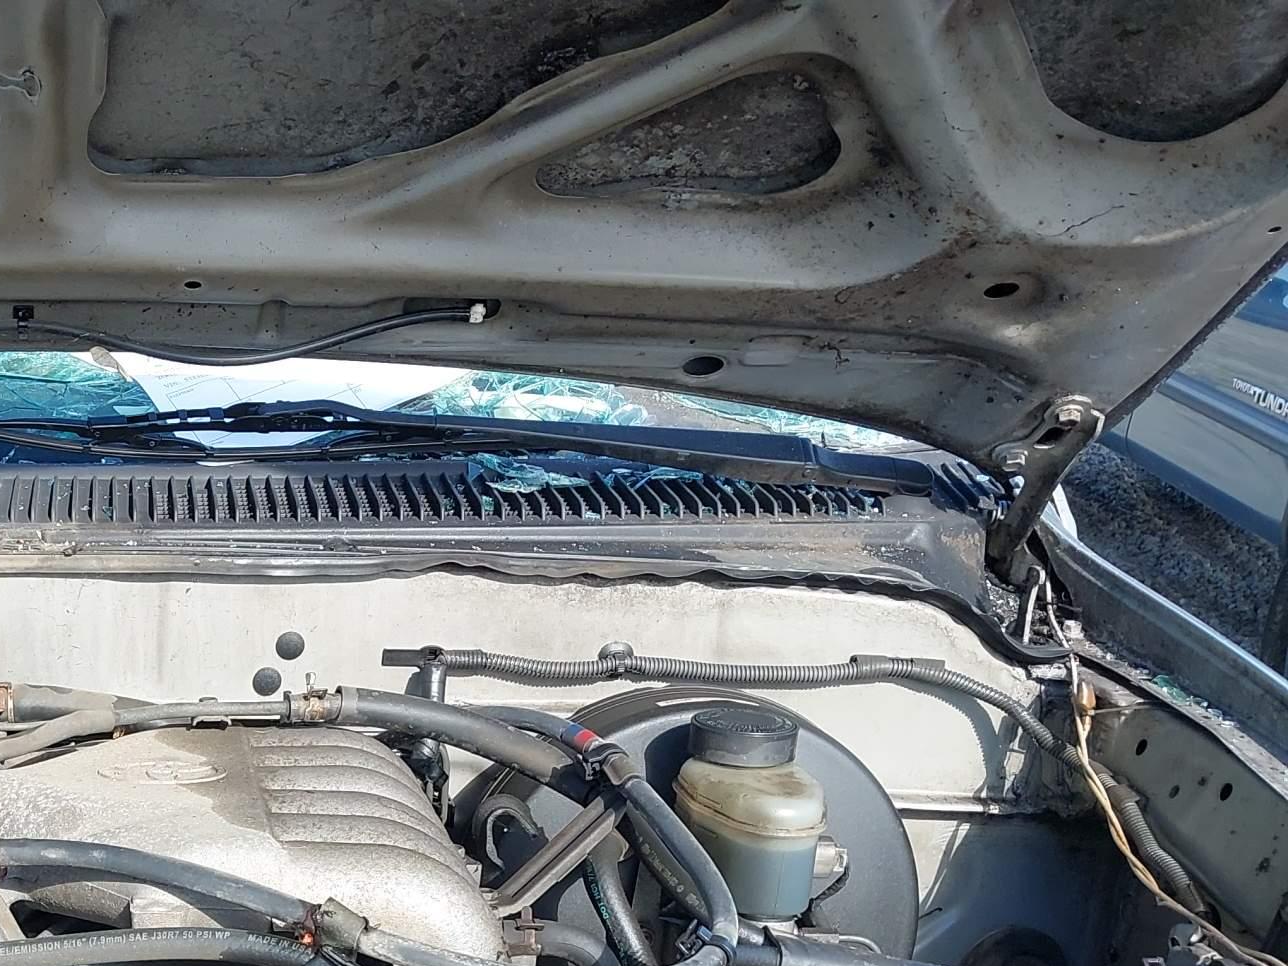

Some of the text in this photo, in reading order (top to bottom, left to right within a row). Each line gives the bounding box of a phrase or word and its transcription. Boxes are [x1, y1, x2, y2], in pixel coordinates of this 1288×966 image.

[88, 934, 127, 948] (7.9mm)
[128, 932, 148, 942] SAE
[151, 930, 180, 941] J30R7
[182, 930, 193, 939] 50
[196, 930, 212, 939] PSI
[214, 931, 231, 940] WP
[247, 933, 276, 947] MADE
[279, 939, 289, 949] IN
